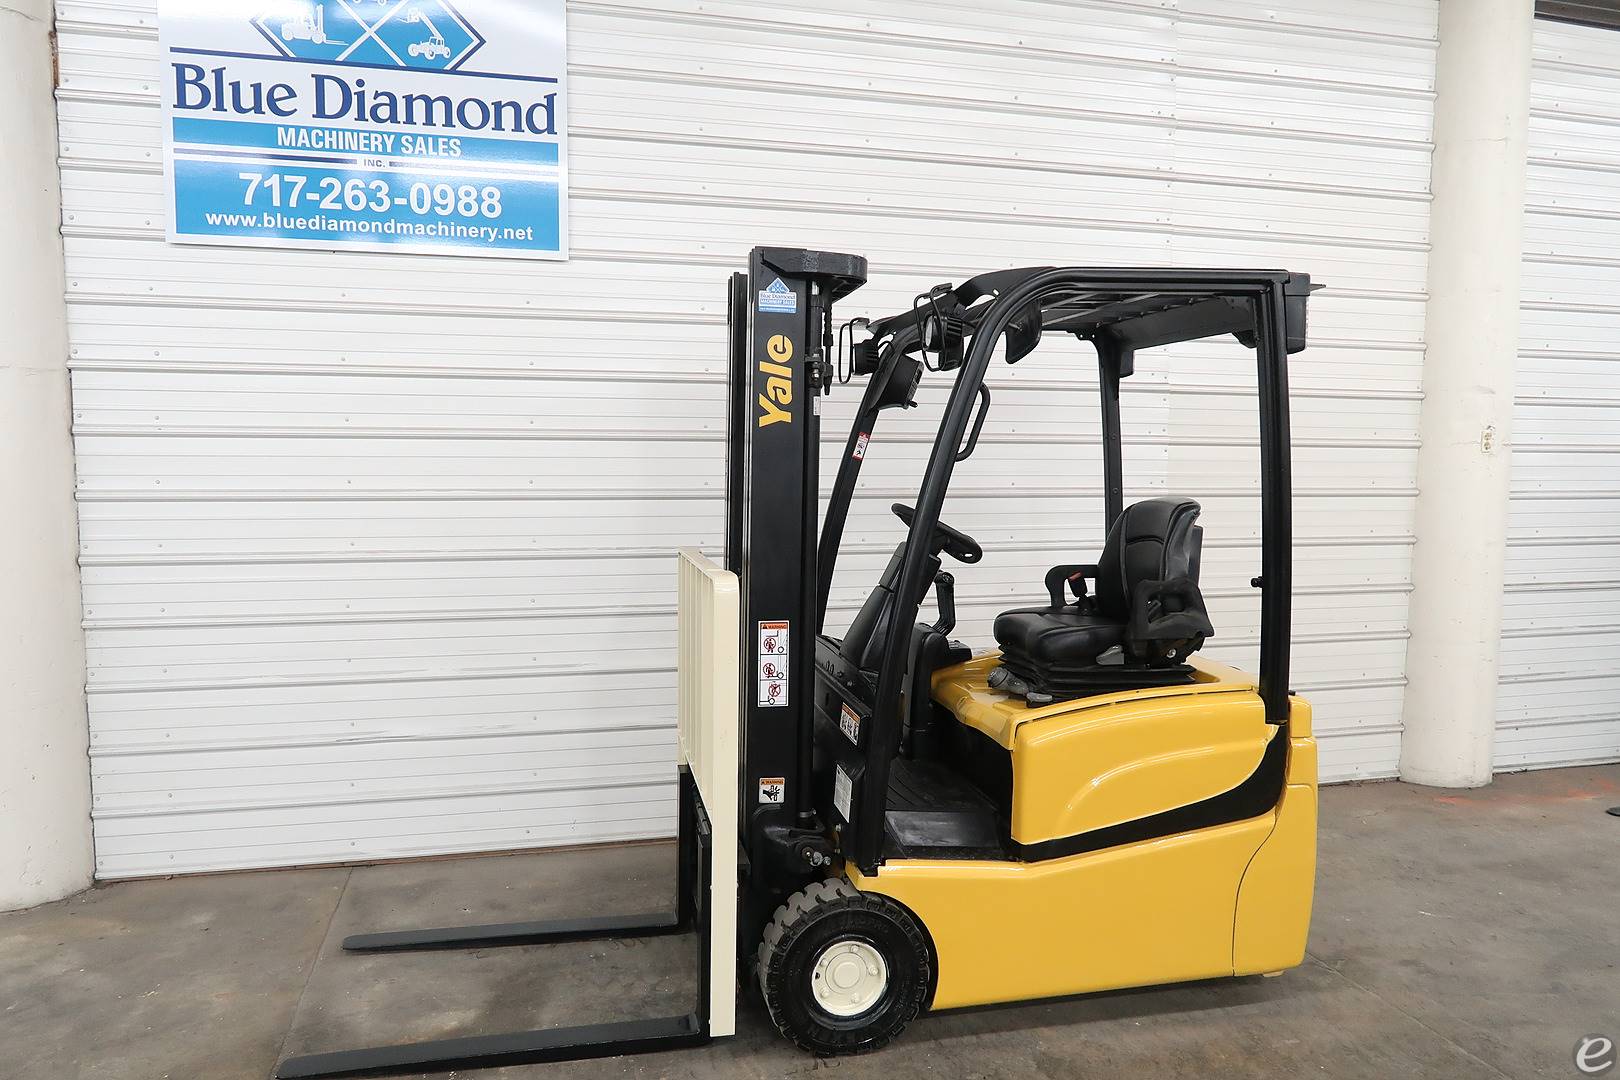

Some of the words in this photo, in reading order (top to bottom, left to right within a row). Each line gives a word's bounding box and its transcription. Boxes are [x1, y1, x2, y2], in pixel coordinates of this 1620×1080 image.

[171, 62, 297, 116] Blue
[311, 73, 558, 136] Diamond
[277, 126, 394, 154] MACHINERY
[400, 134, 462, 158] SALES
[363, 158, 386, 168] INC.
[239, 172, 502, 219] 717-263-0988
[205, 210, 533, 241] www.bluediamondmachinery.net
[758, 334, 793, 428] Yale
